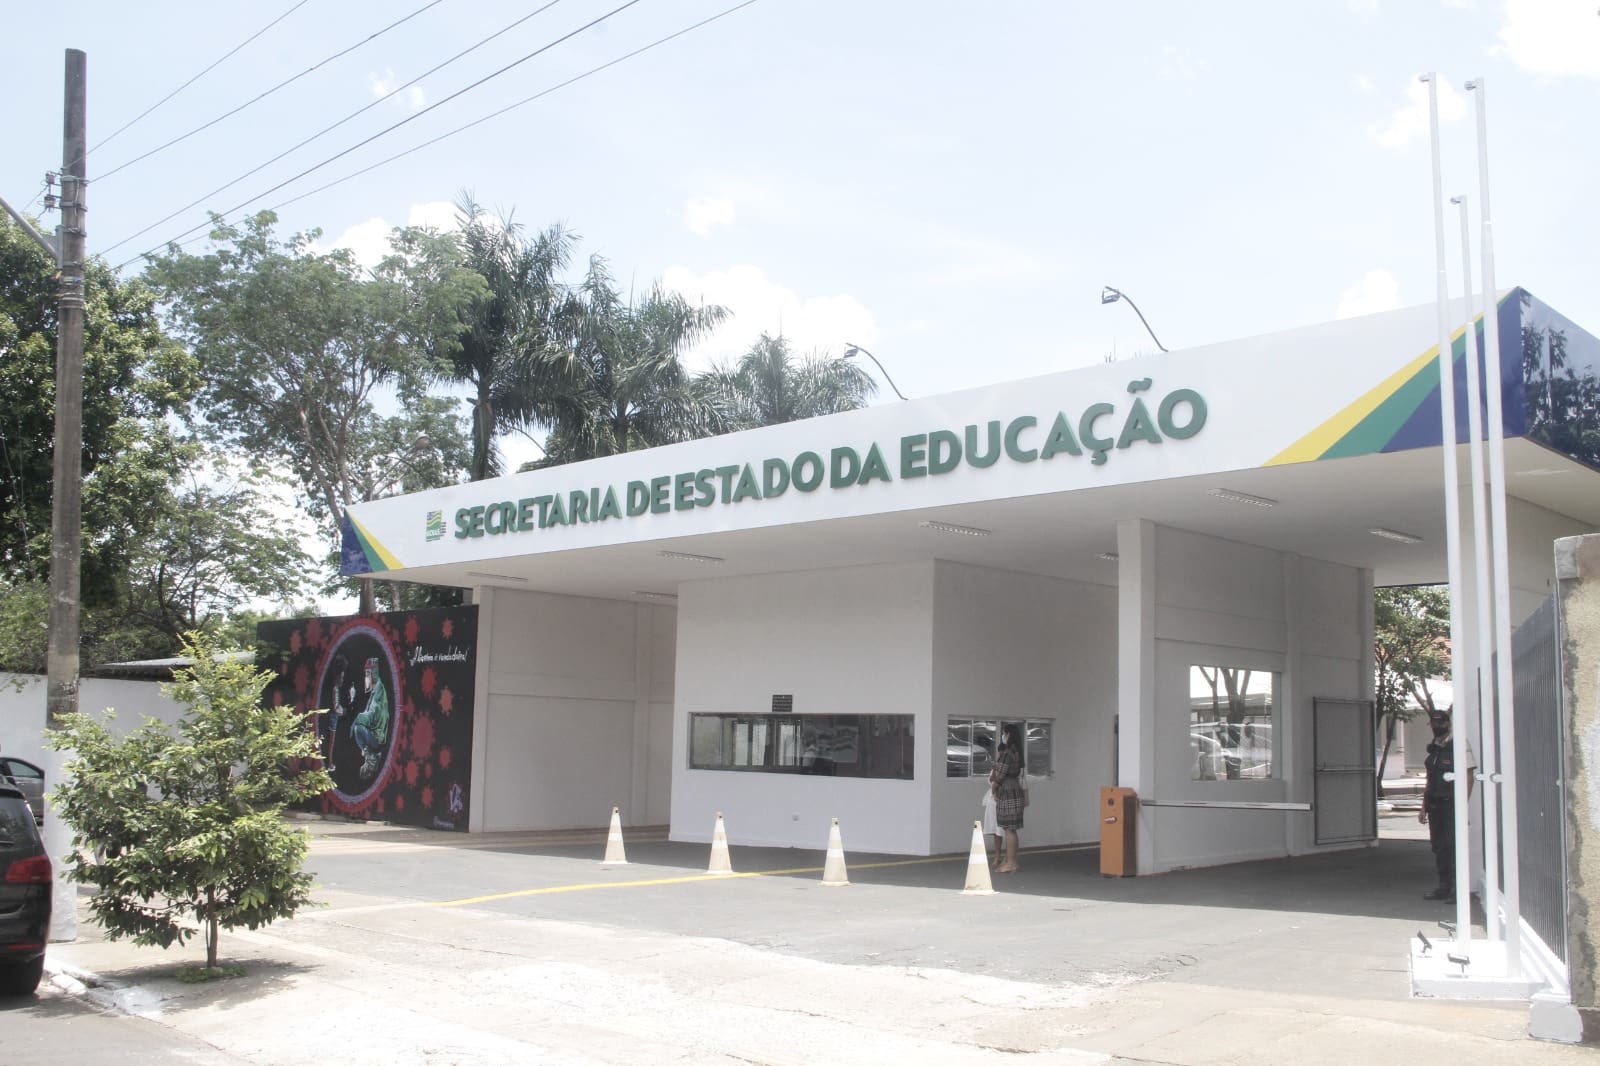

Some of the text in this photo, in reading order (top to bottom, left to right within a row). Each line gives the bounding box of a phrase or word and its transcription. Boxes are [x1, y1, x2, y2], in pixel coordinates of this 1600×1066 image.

[454, 377, 1208, 540] SECRETARIA DE ESTADO DA EDUCAÇÃO
